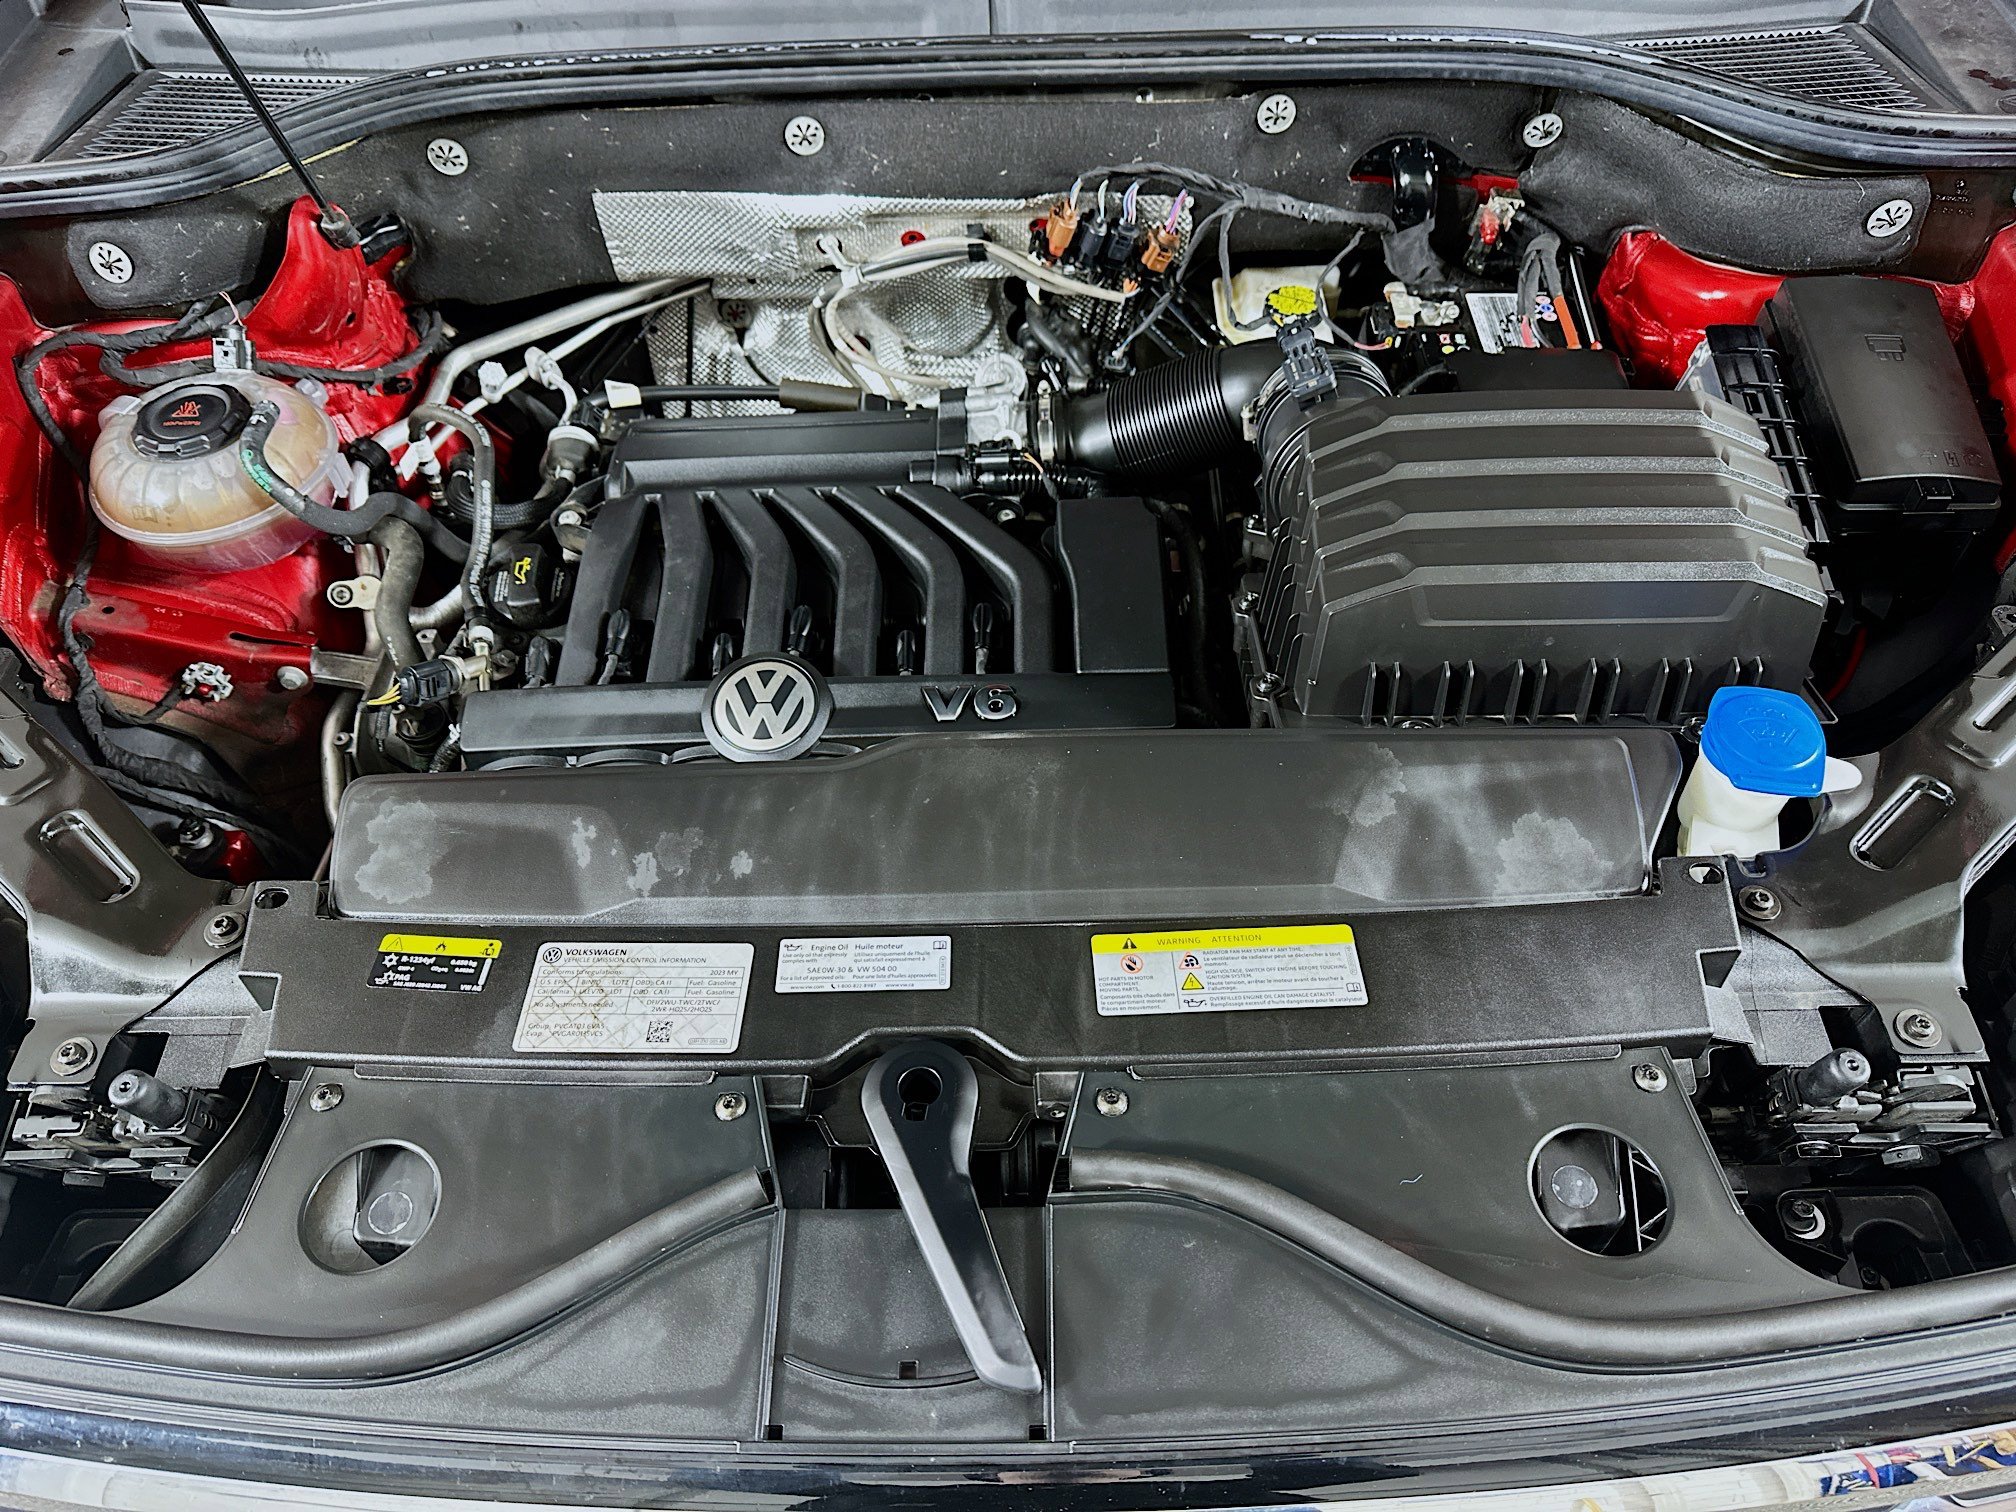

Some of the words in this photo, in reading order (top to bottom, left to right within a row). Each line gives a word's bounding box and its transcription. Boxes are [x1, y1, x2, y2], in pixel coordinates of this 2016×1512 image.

[922, 684, 1017, 721] V6
[1157, 937, 1201, 946] WARNING
[1211, 934, 1262, 943] ATTENTION
[810, 944, 837, 952] Engine
[707, 979, 737, 987] Gasoline
[706, 989, 735, 997] Gasoline
[545, 1001, 588, 1010] adjustments
